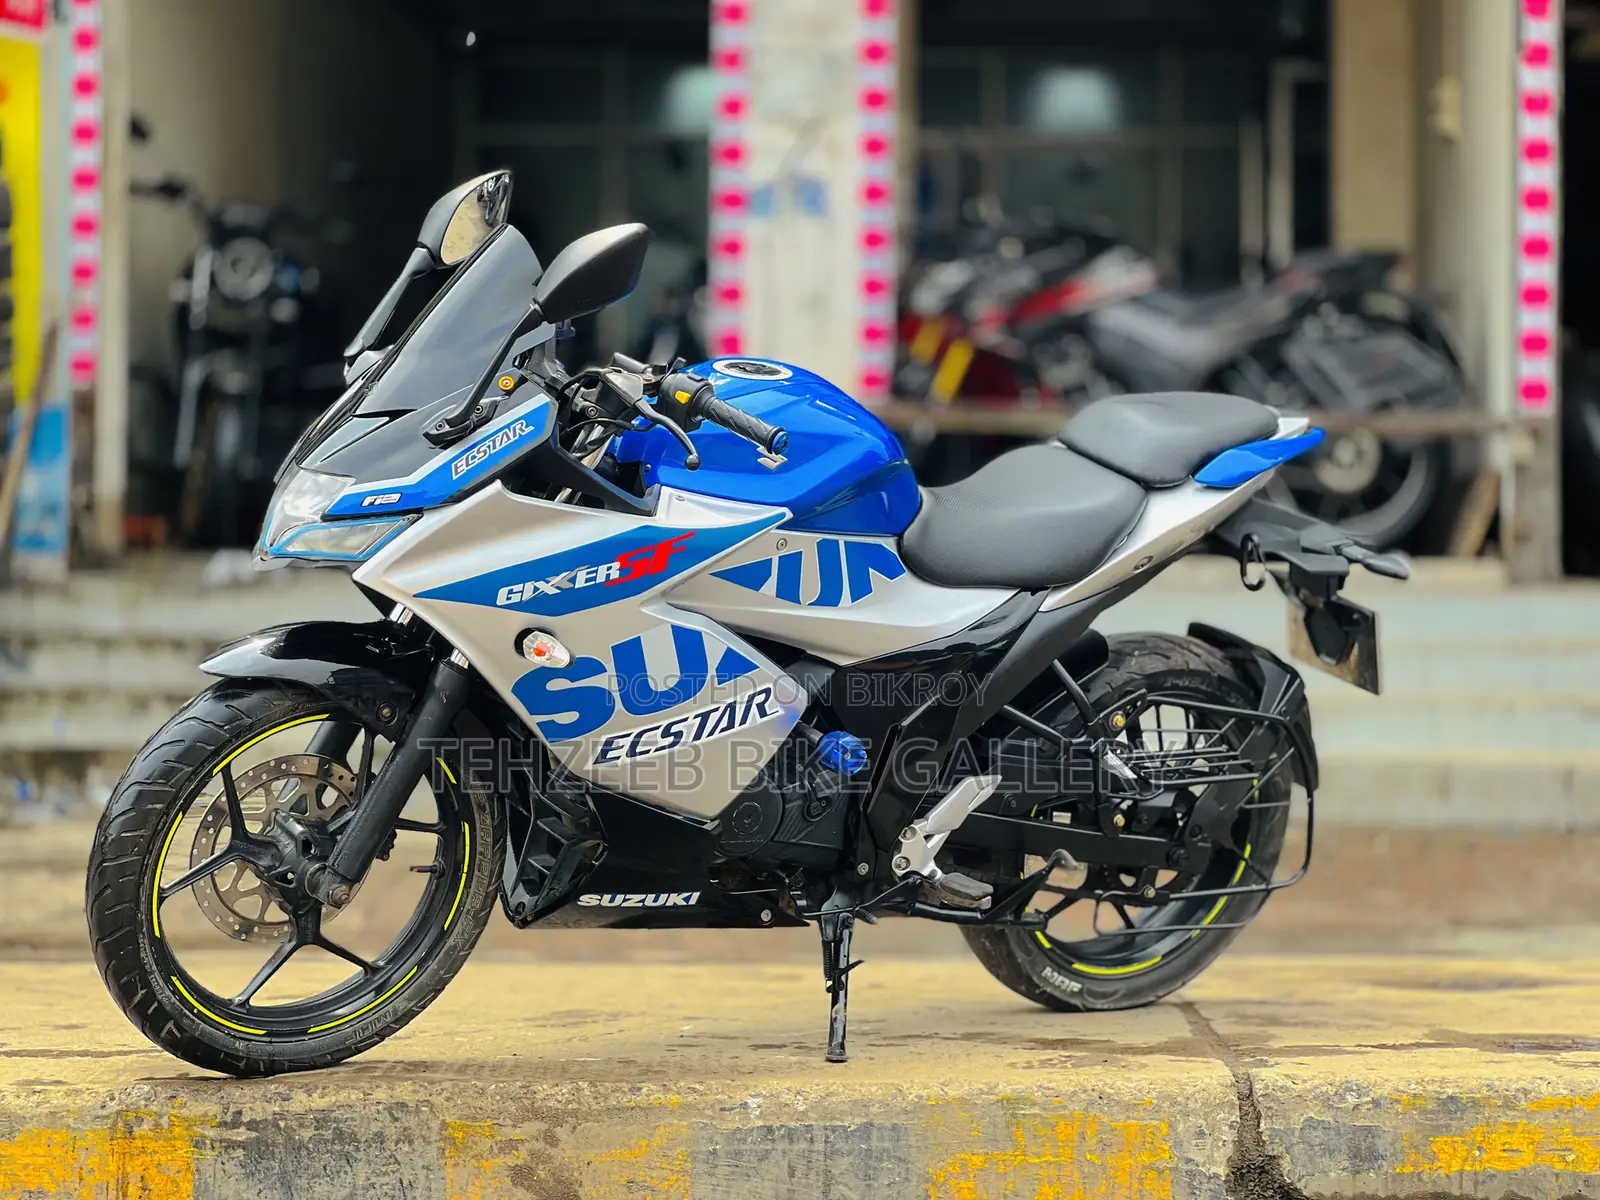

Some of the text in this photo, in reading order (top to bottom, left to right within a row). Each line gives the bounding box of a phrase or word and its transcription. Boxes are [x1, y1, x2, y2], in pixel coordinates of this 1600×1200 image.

[452, 419, 534, 480] ECSTAR
[590, 685, 781, 767] ECSTAR
[576, 891, 700, 908] SUZUKI
